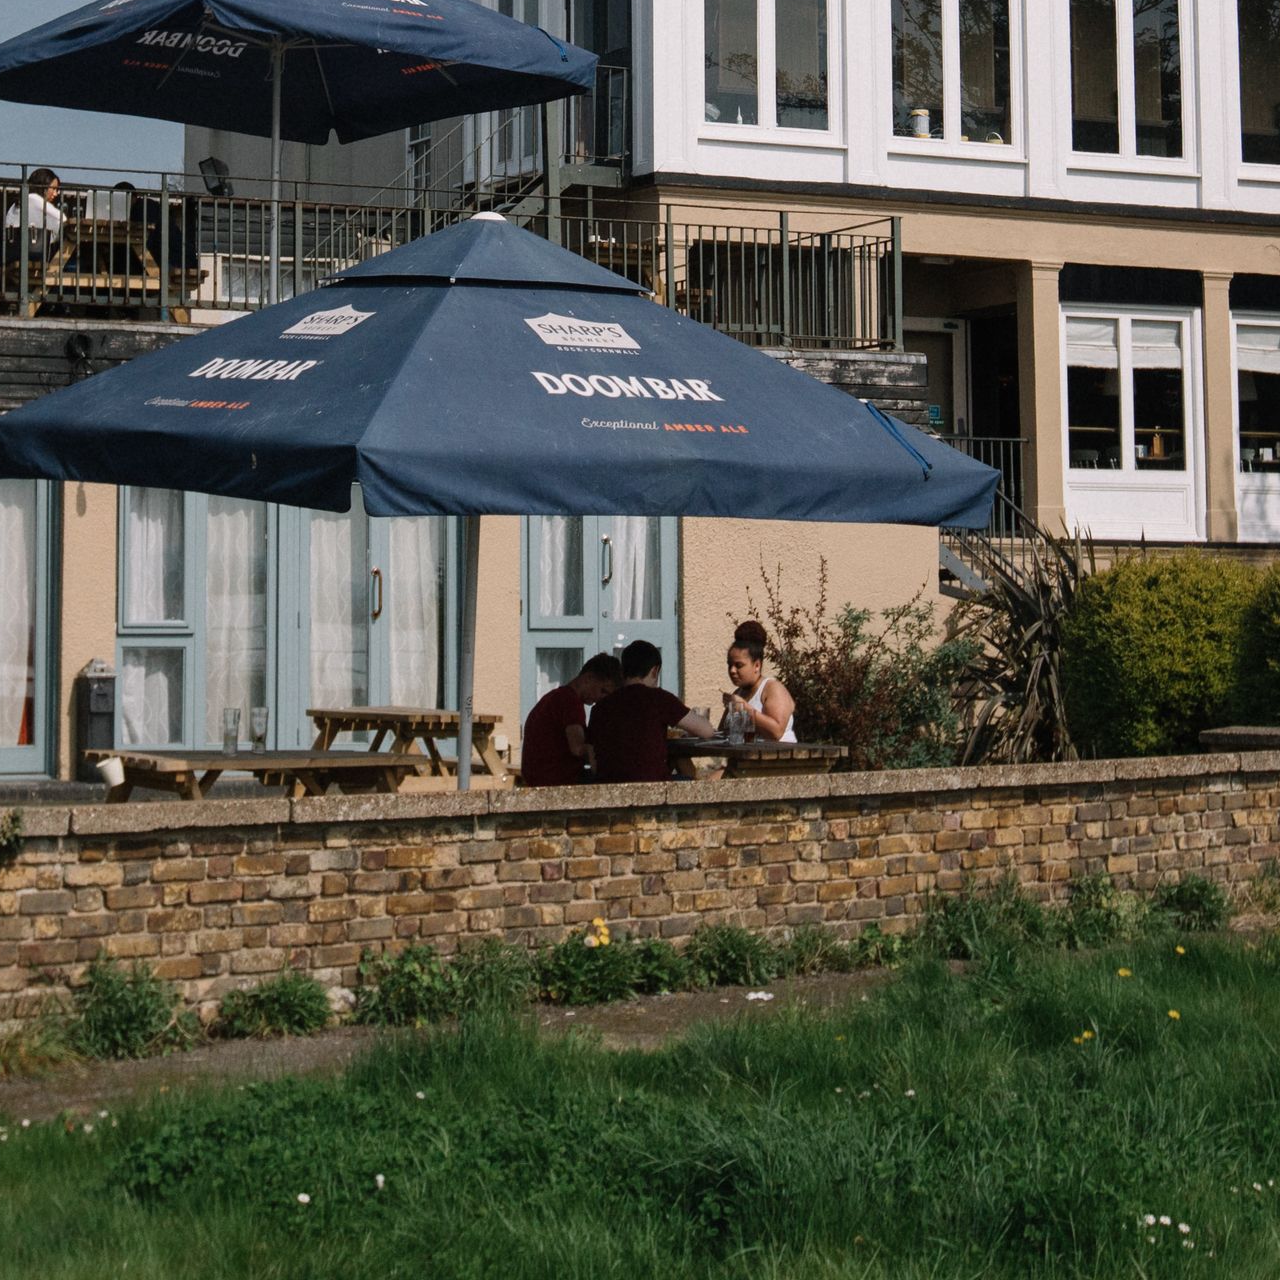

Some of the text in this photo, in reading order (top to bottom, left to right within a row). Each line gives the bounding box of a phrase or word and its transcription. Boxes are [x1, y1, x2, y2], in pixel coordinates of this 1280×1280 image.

[537, 323, 622, 338] SHARP'S
[556, 345, 640, 356] ROCK CORNWALL
[188, 357, 318, 381] DOOM BAR
[531, 371, 726, 402] DOOM BAR
[581, 417, 749, 434] Exceptional AMBER ALE
